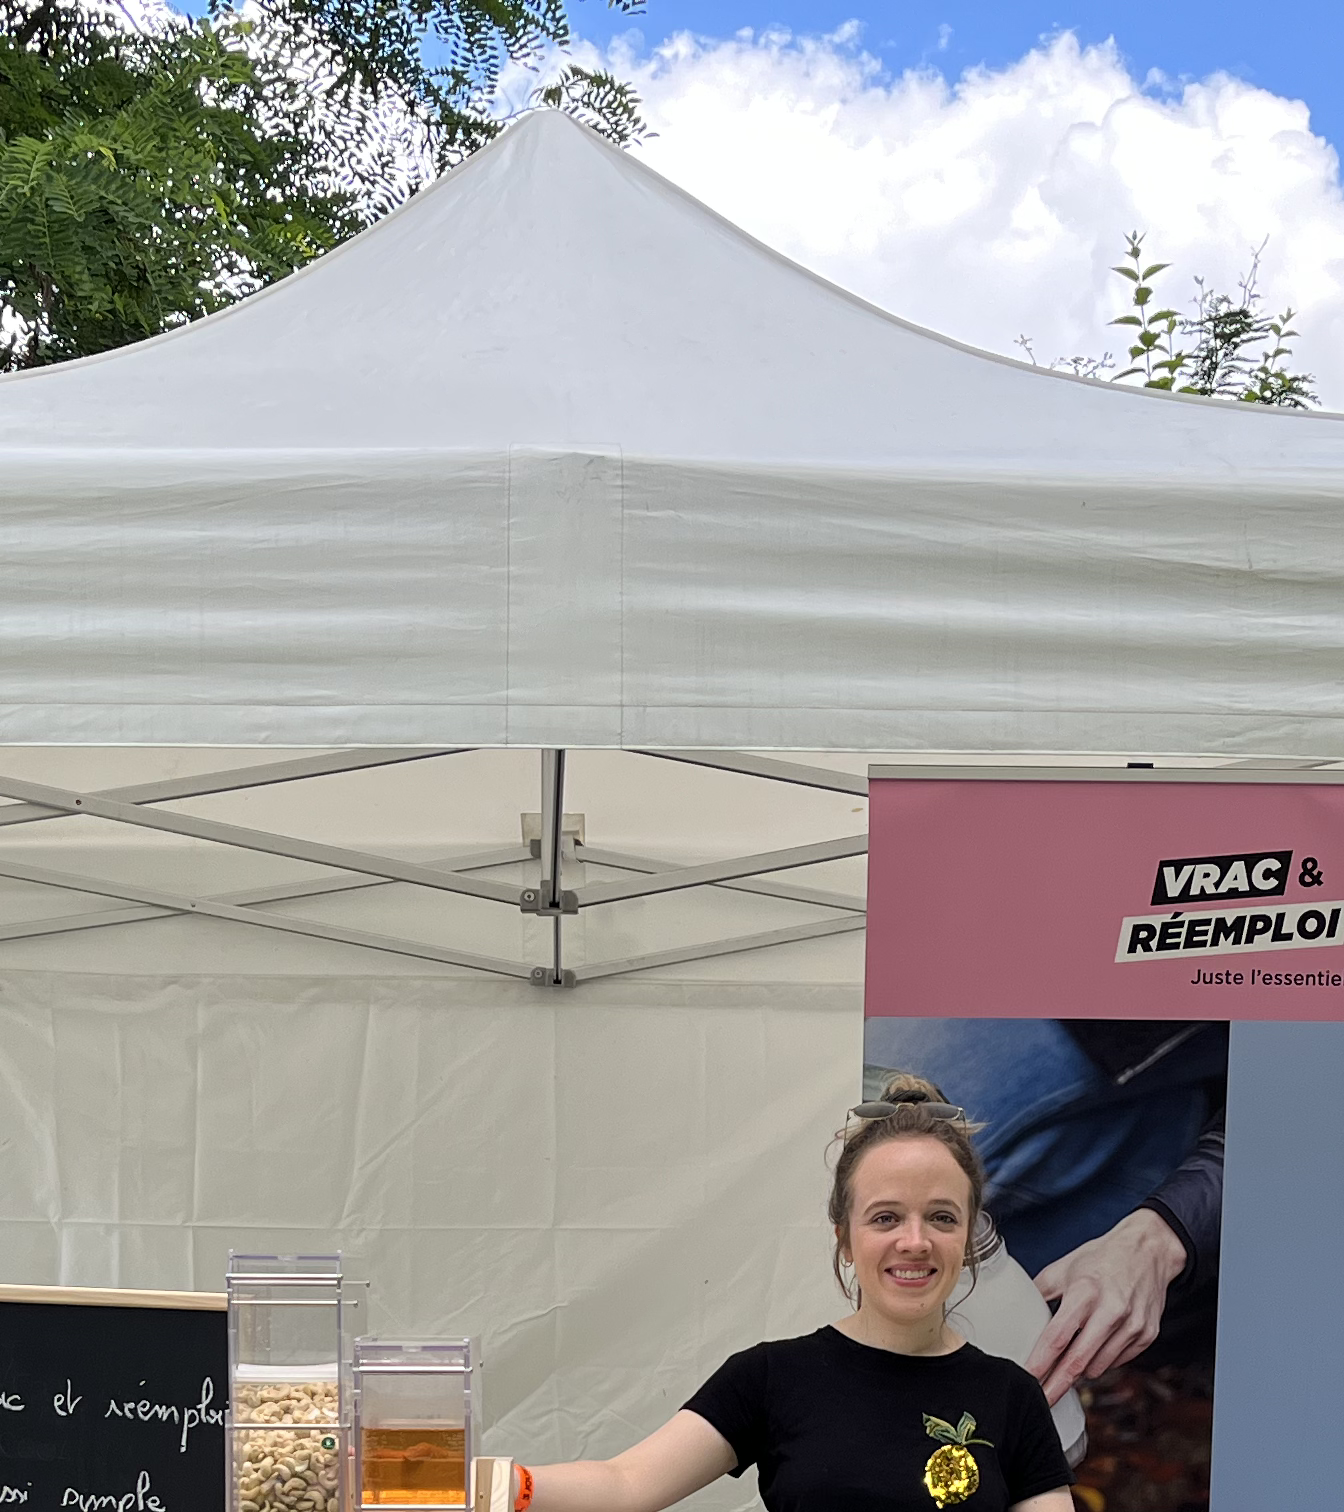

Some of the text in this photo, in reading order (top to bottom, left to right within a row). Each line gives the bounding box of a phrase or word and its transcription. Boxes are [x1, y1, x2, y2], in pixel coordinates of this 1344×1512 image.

[1162, 857, 1324, 898] VRAC &
[1126, 907, 1342, 954] RÉEMPLOI
[1189, 969, 1244, 987] Juste
[53, 1377, 83, 1420] et
